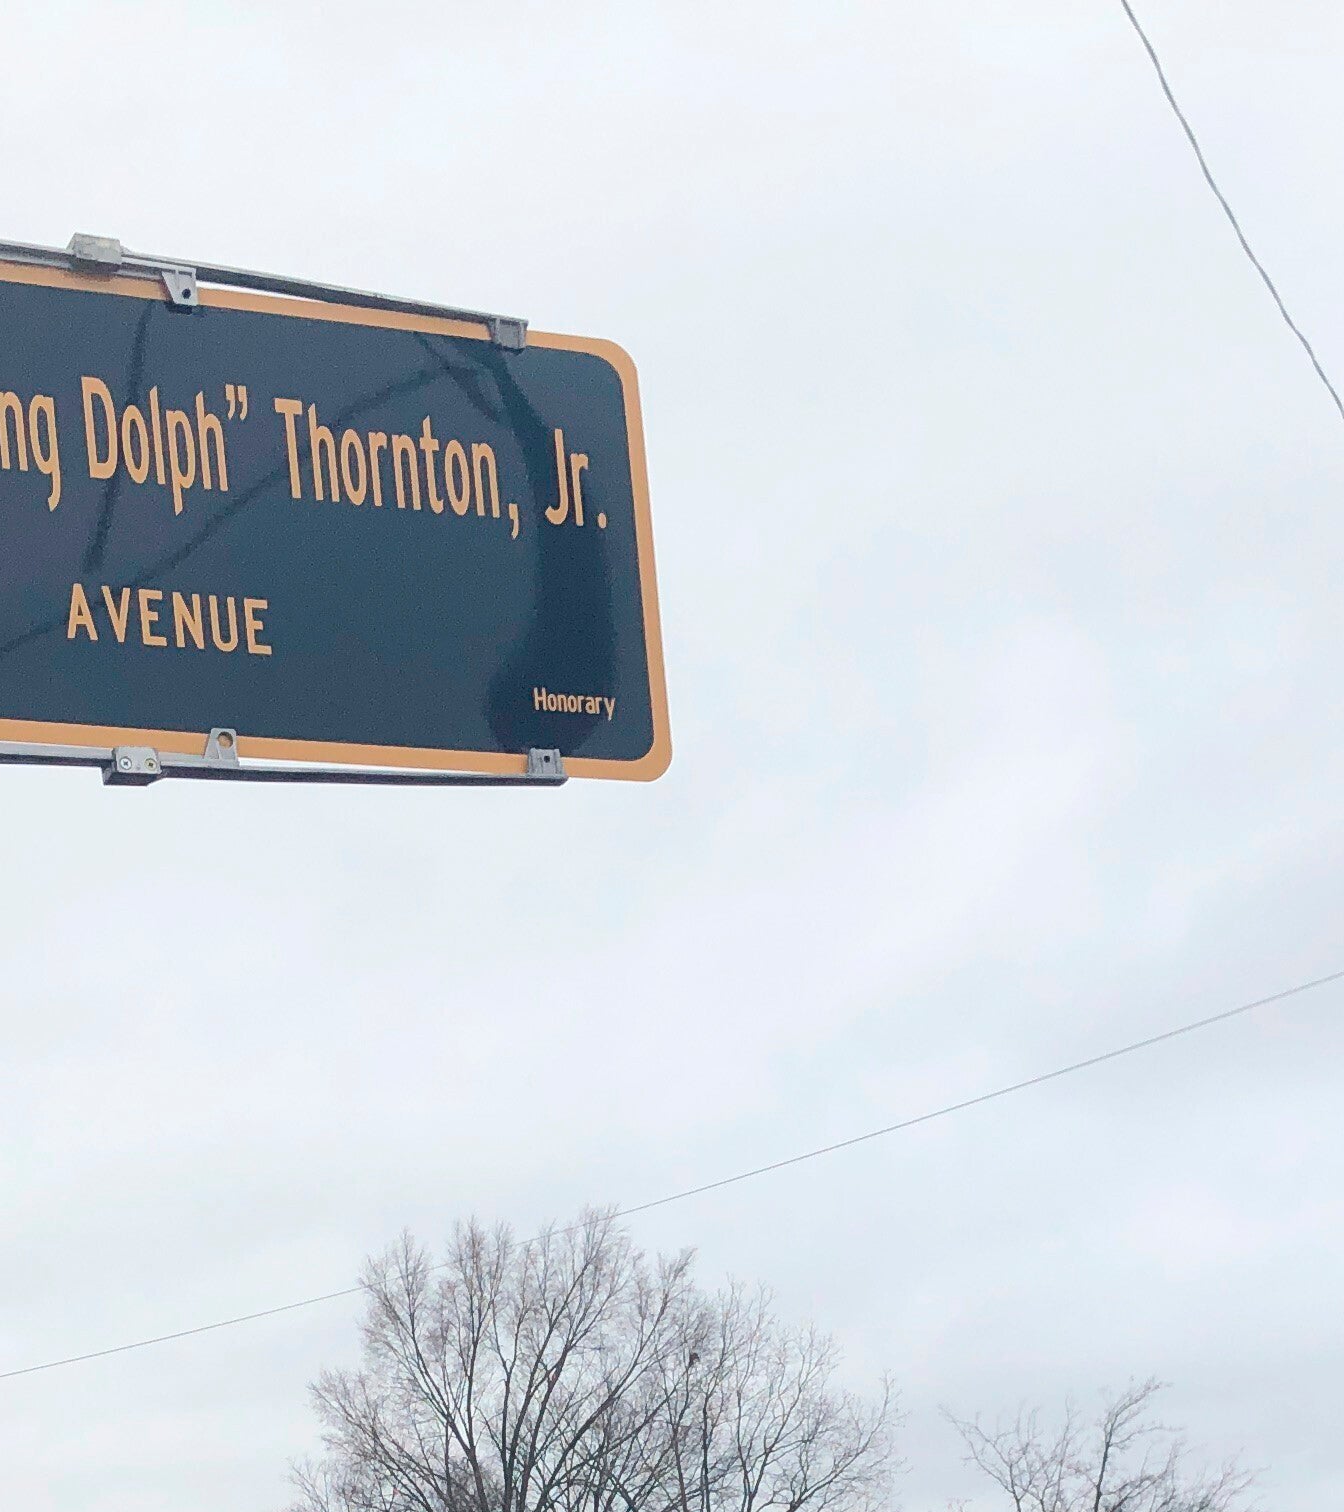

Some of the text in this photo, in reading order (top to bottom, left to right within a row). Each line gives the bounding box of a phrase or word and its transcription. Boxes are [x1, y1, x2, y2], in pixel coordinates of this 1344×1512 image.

[82, 374, 248, 517] Dolph”
[274, 398, 521, 541] Thornton,
[544, 428, 610, 533] Jr.
[68, 584, 274, 657] AVENUE
[532, 686, 615, 722] Honorary
